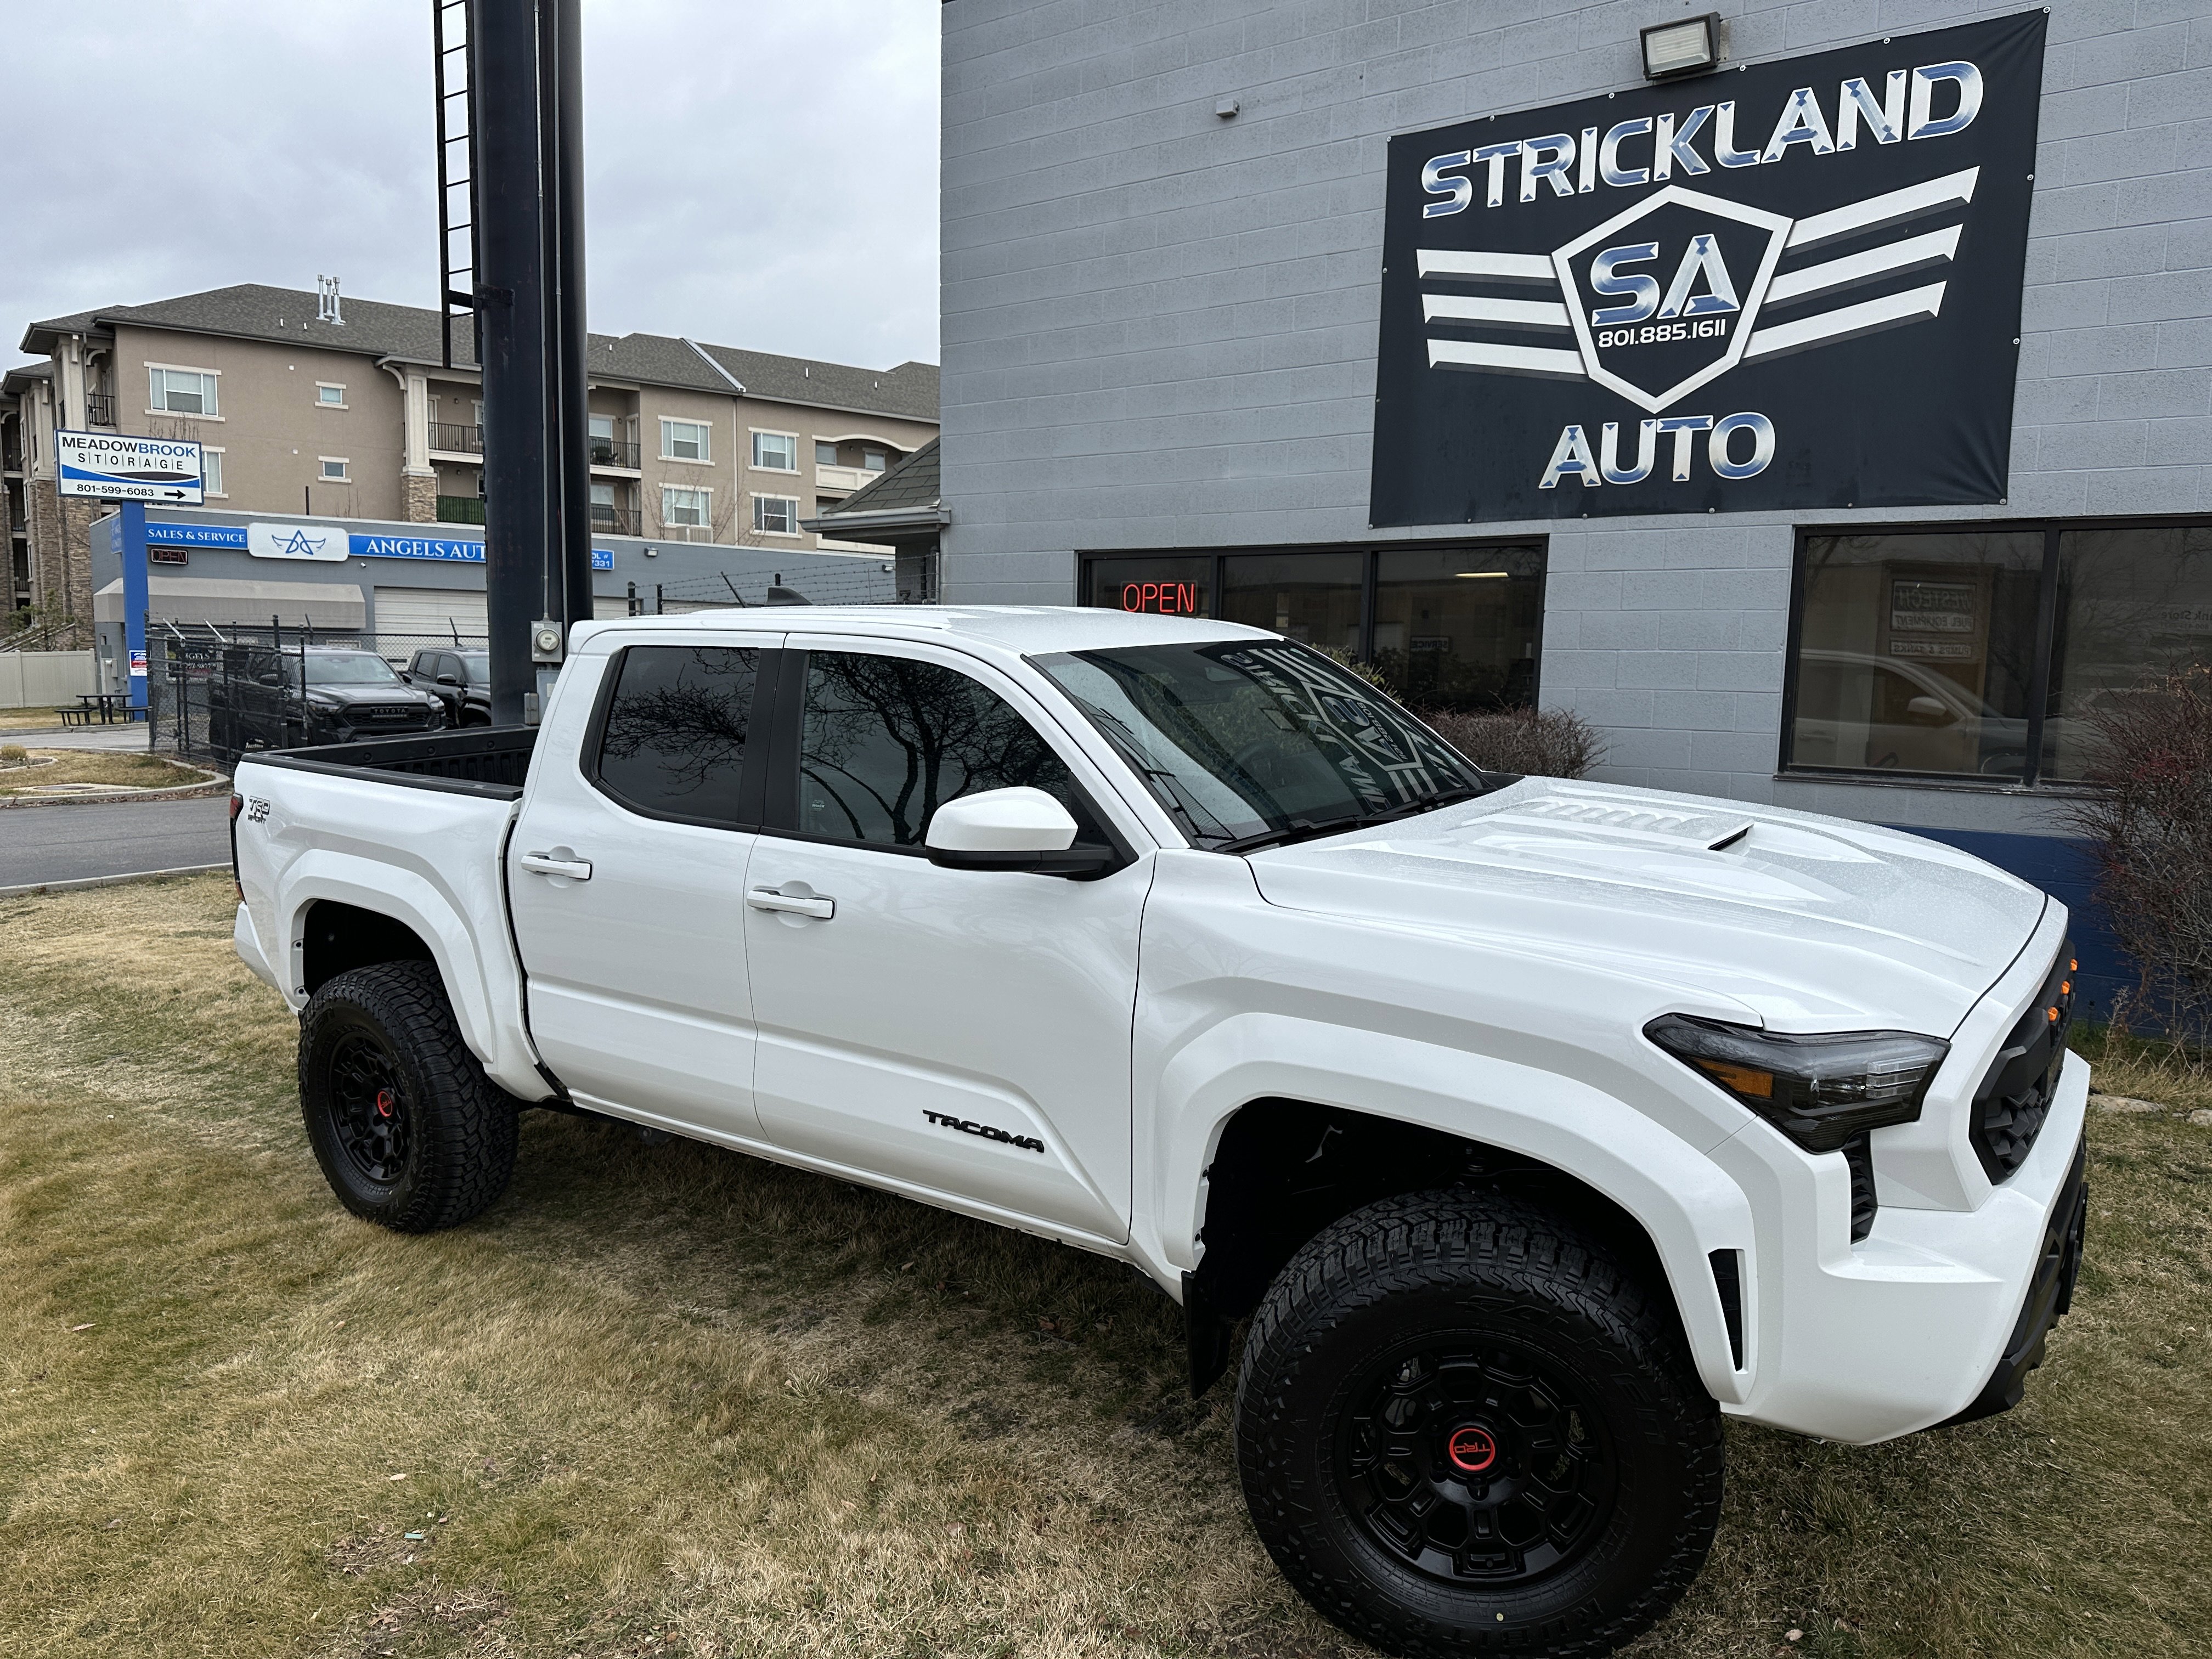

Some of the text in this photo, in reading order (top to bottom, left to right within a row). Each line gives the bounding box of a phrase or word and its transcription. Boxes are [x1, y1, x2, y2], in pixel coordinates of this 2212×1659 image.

[1422, 60, 1984, 218] STRICKLAND
[1591, 234, 1741, 326] SA
[1599, 318, 1726, 349] 801.885.1611
[62, 437, 196, 458] MEADOWBROOK
[1539, 411, 1776, 489] AUTO
[77, 484, 154, 496] 801-599-6083
[148, 528, 245, 543] SALES & SERVICE
[153, 550, 187, 562] OPEN
[366, 539, 445, 557] ANGELS
[1123, 583, 1194, 613] OPEN
[249, 795, 270, 818] TRD
[922, 1109, 1045, 1153] TACOMA
[1454, 1442, 1491, 1454] TRD
